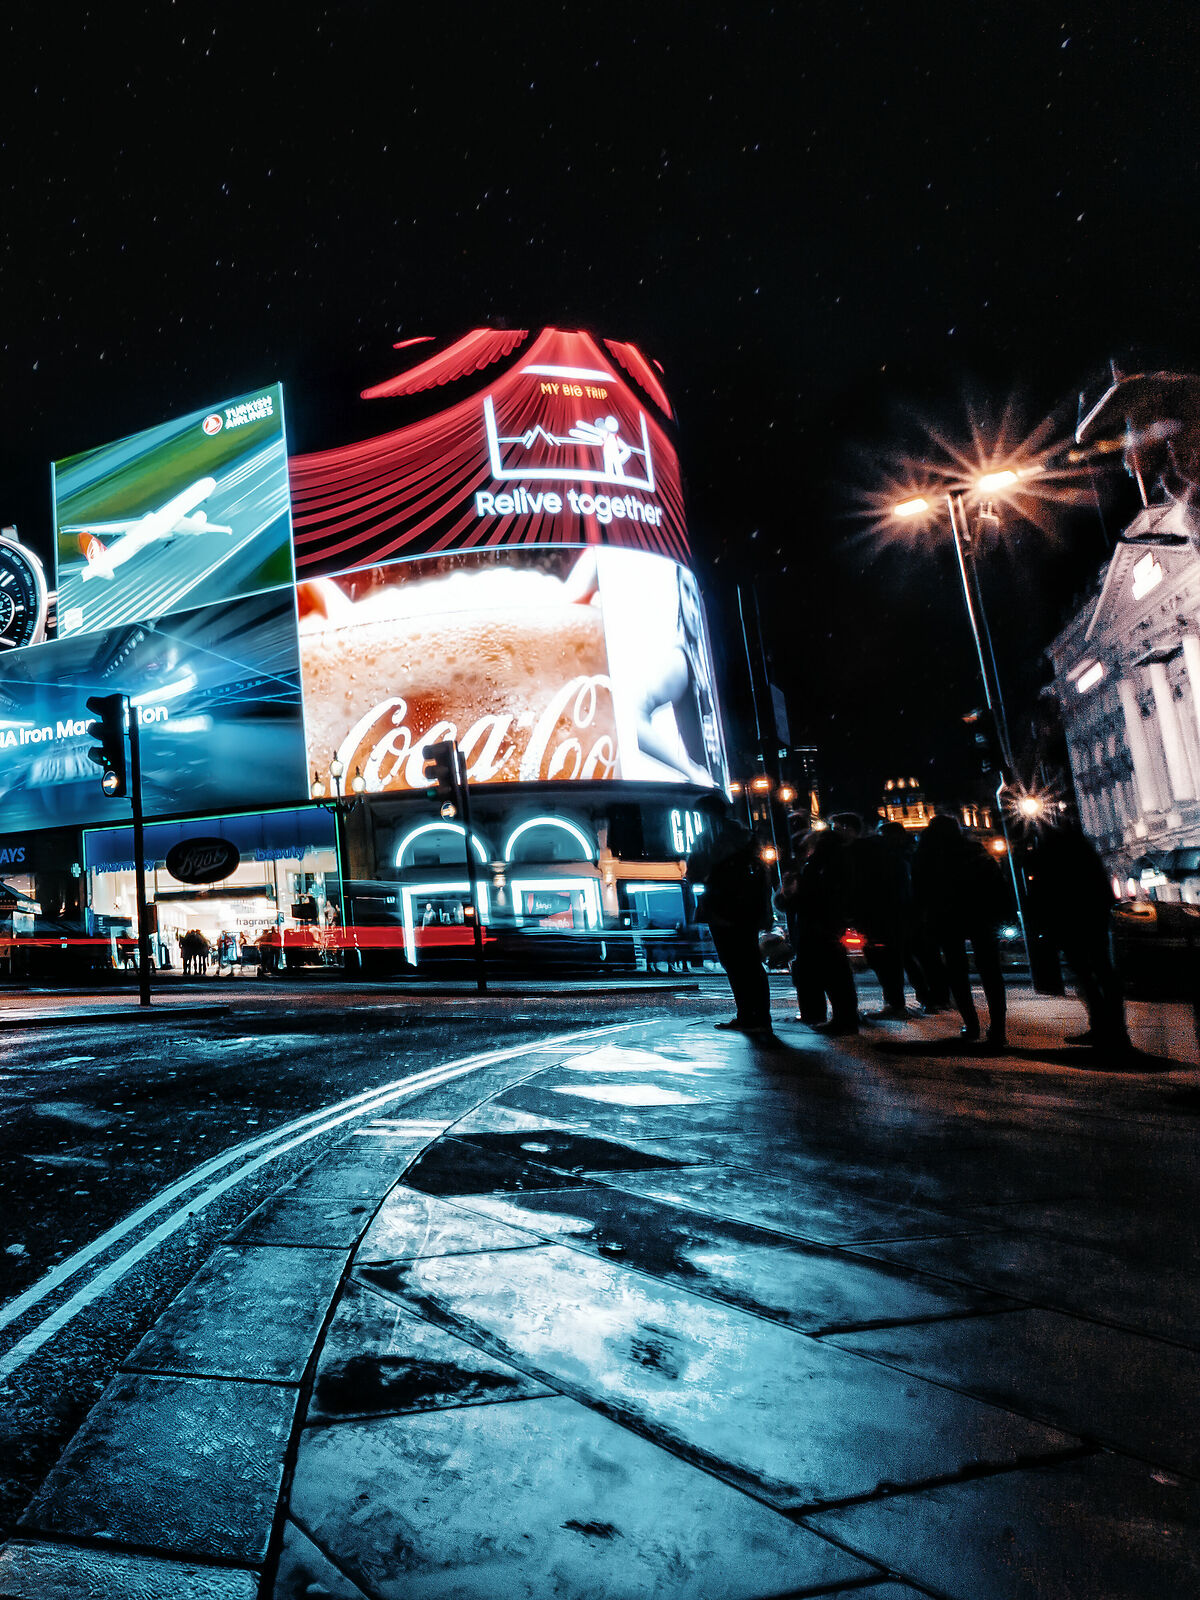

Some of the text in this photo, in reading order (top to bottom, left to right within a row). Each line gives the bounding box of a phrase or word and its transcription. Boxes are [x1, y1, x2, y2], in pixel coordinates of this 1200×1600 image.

[540, 382, 608, 400] MY BIG TRIP
[224, 395, 272, 420] TURKISH
[224, 406, 274, 430] AIRLINES
[475, 487, 662, 526] Relive together
[20, 726, 53, 745] Iron
[255, 845, 305, 861] beauty
